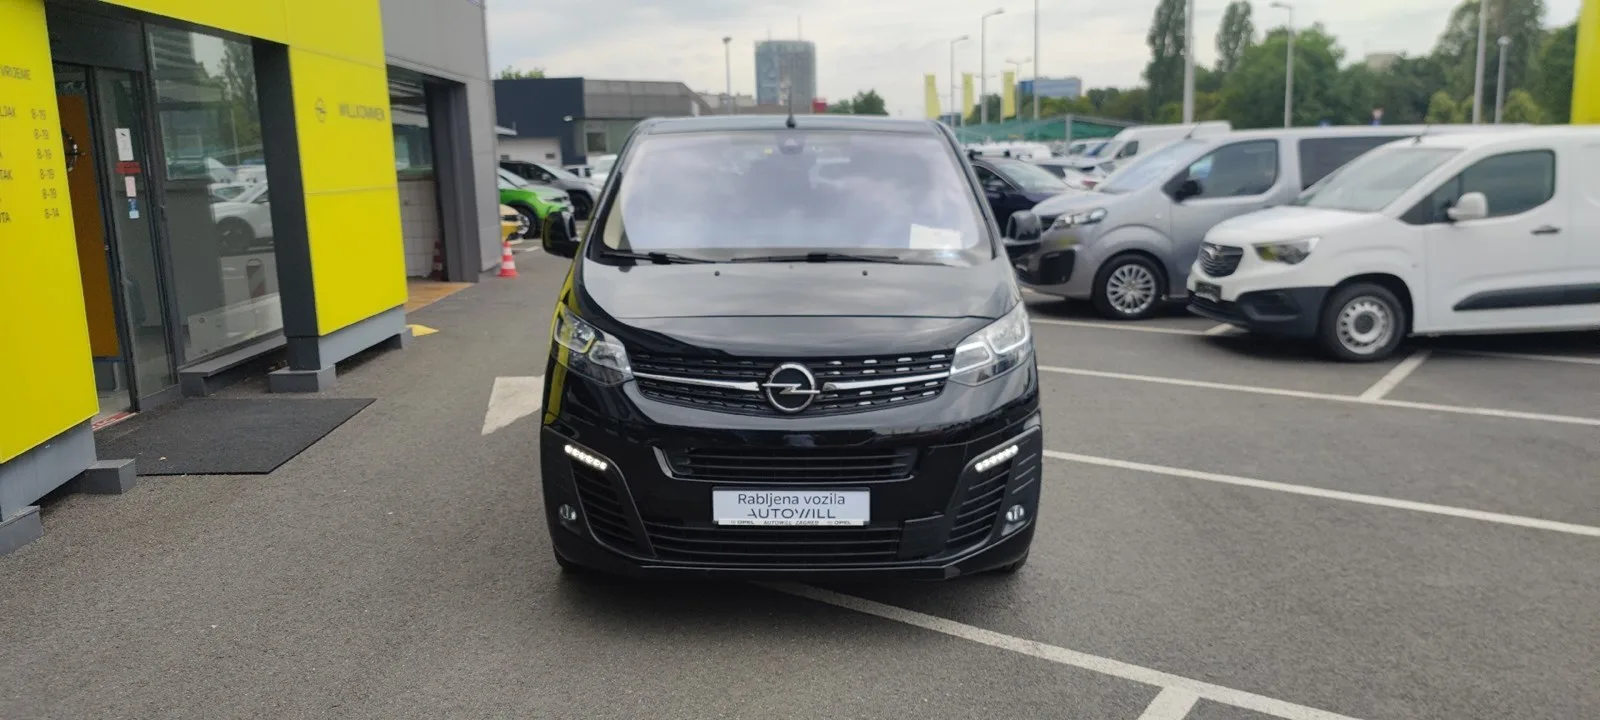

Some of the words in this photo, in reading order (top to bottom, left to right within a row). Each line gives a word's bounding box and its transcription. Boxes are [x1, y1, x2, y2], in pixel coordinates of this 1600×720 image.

[738, 493, 799, 507] Rabljena
[803, 492, 846, 505] vozila
[747, 508, 837, 519] AUTOWILL
